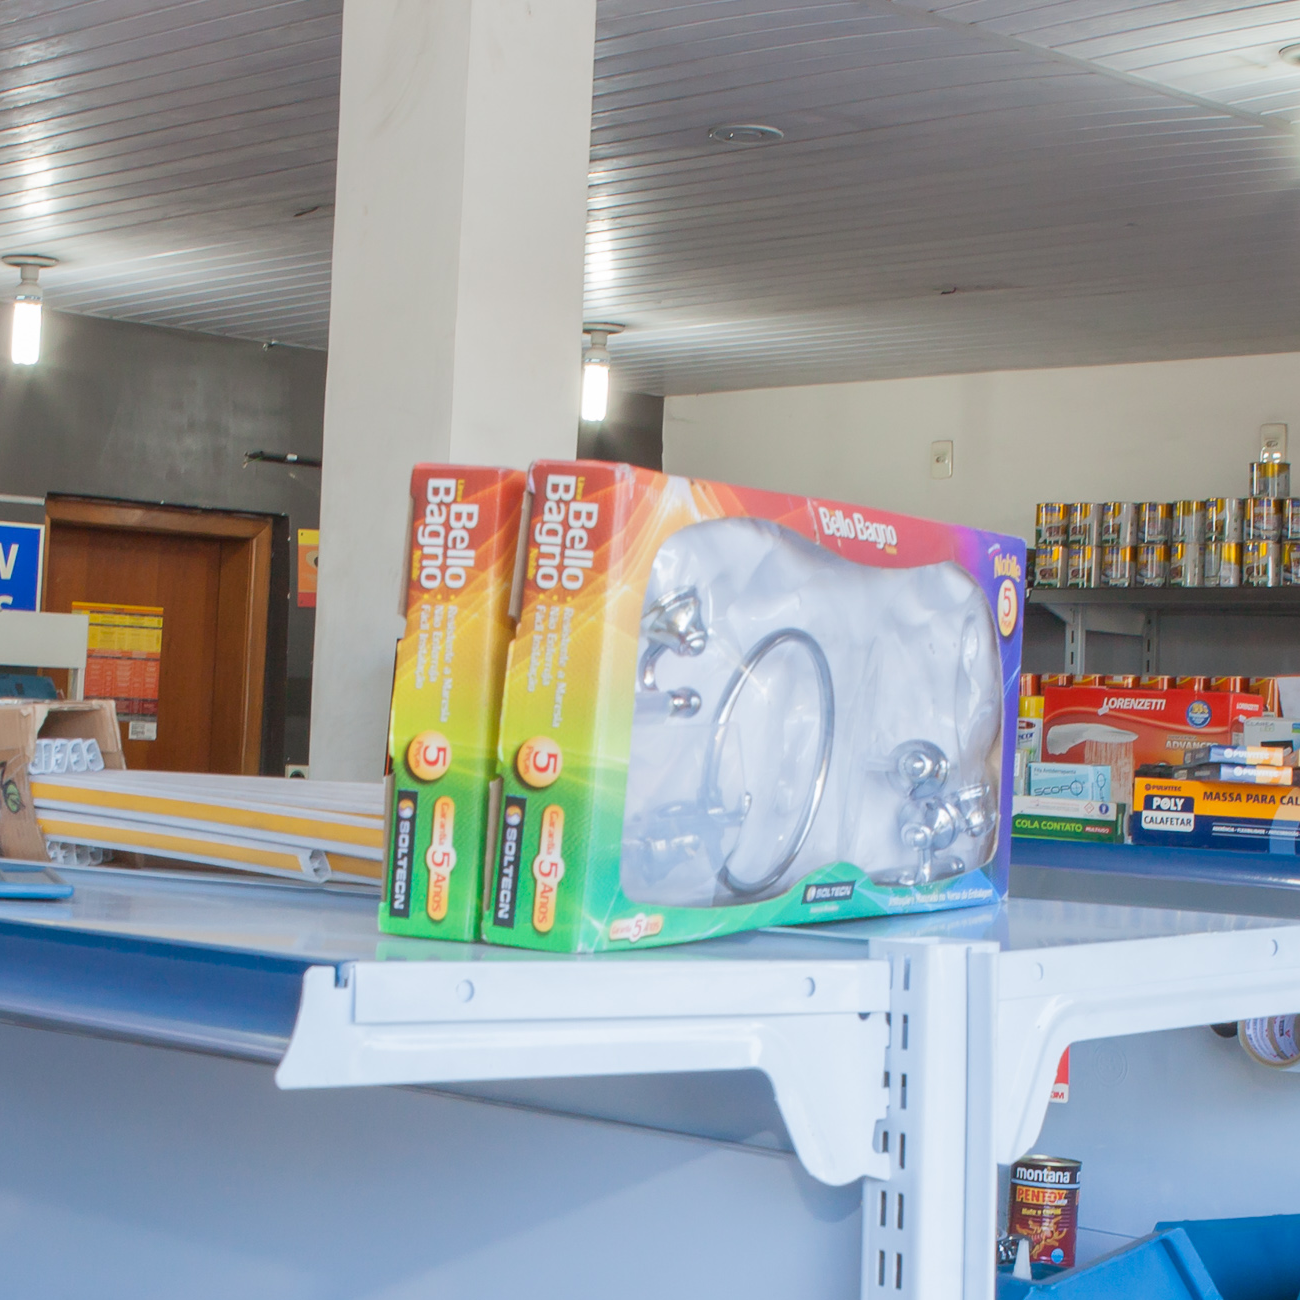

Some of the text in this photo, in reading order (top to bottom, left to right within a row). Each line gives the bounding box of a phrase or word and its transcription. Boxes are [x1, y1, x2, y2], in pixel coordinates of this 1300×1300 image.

[417, 478, 457, 589] Bagno
[534, 475, 576, 589] Bagno
[818, 507, 898, 549] Bello Bagno
[444, 503, 480, 589] Bello
[561, 501, 599, 590] Bello
[1003, 588, 1012, 617] 5
[1102, 697, 1166, 711] LORENZETTI
[423, 747, 447, 767] 5
[533, 752, 558, 774] 5
[1152, 797, 1185, 811] POLY
[1202, 791, 1243, 804] MASSA
[1245, 793, 1277, 806] PARA
[1015, 818, 1083, 833] COLA CONTATO
[1144, 814, 1192, 828] CALAFETAR
[393, 820, 411, 910] SOLTECN
[432, 851, 450, 867] 5
[538, 860, 559, 878] 5
[498, 827, 518, 920] SOLTECN
[432, 872, 447, 912] Anos
[538, 883, 554, 924] Anos
[632, 919, 643, 938] 5
[1016, 1167, 1071, 1184] montana
[1016, 1187, 1066, 1204] PENTOX
